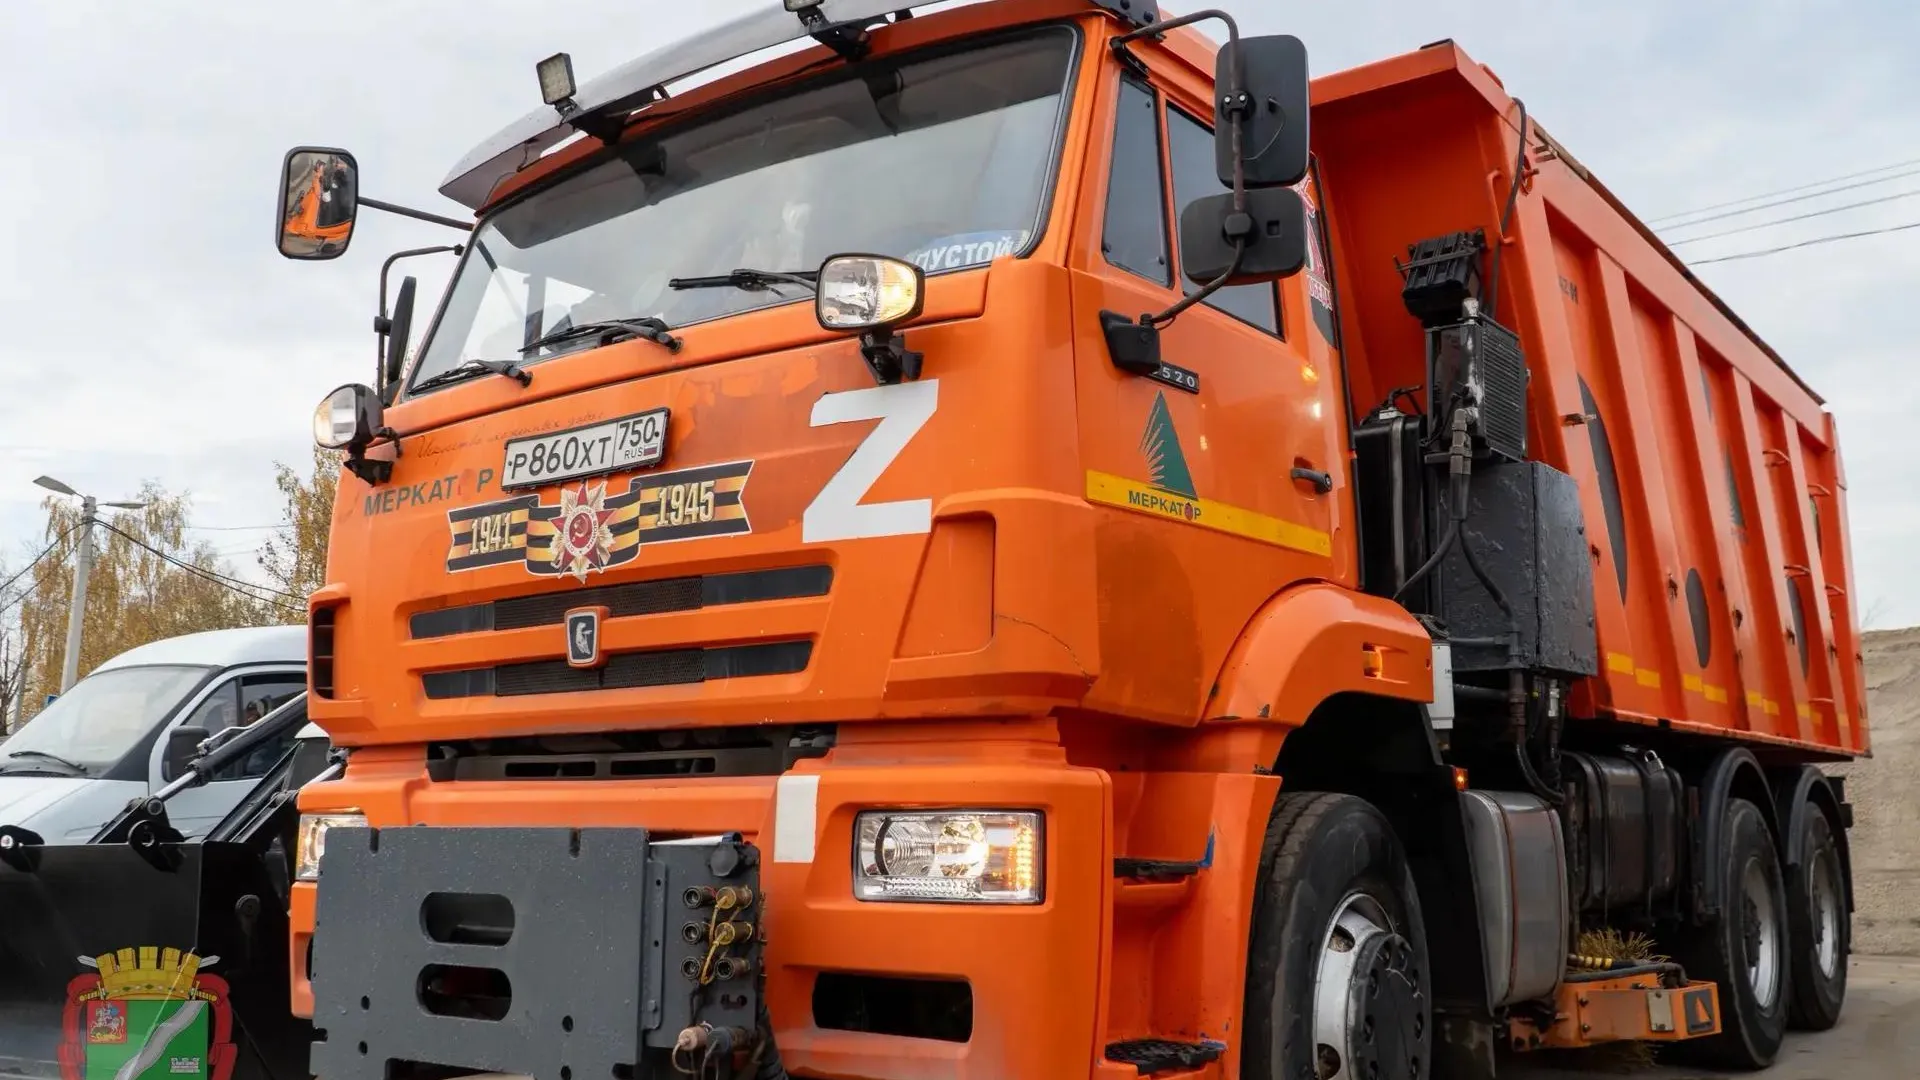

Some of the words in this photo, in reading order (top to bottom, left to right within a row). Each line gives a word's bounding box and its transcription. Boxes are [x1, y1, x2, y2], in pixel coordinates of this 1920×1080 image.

[1153, 366, 1196, 388] 520
[511, 436, 612, 480] Р860ХТ
[618, 416, 656, 451] 750
[624, 446, 644, 460] RUS
[802, 378, 940, 544] Z
[656, 480, 715, 527] 1945
[469, 511, 513, 555] 1941
